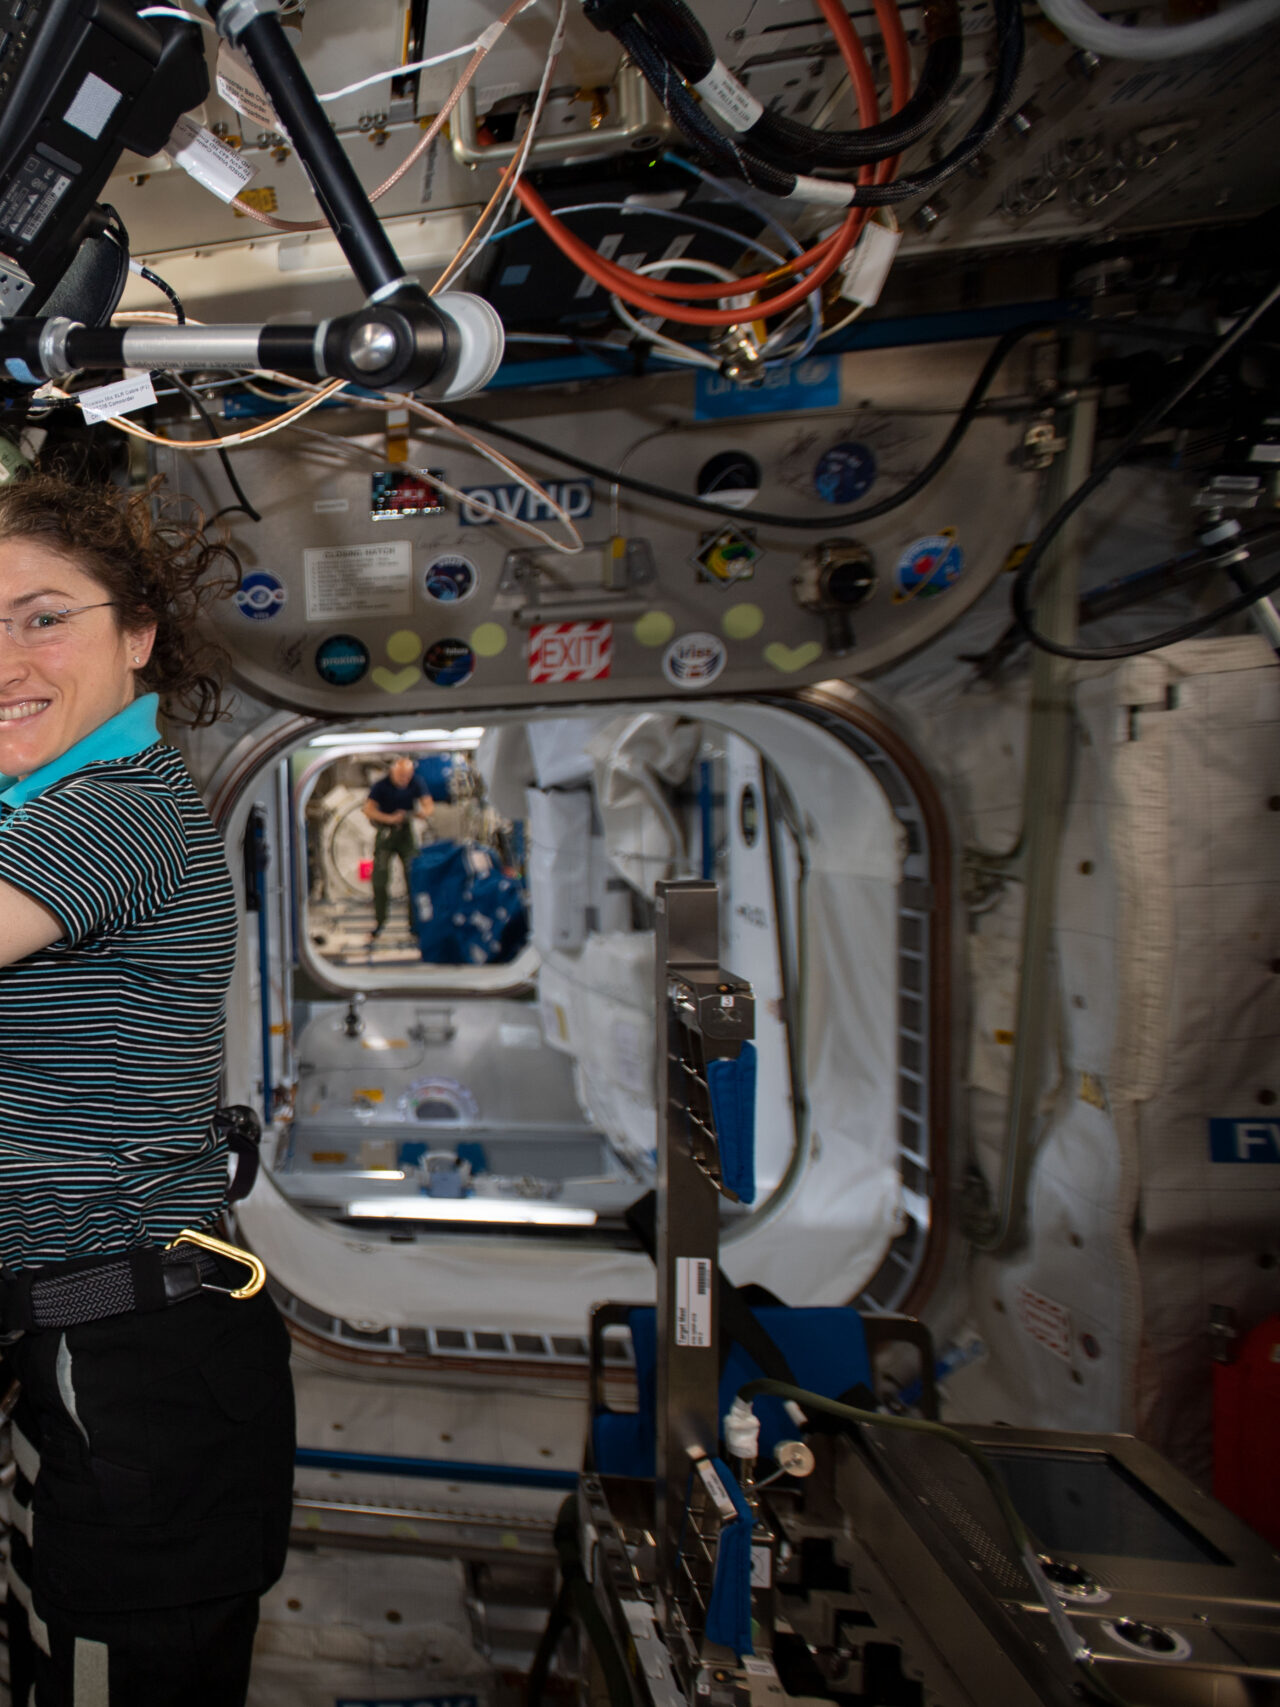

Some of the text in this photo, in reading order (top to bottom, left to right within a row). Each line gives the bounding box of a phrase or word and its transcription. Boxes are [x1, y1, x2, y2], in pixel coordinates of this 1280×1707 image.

[213, 152, 228, 166] Video
[461, 482, 593, 525] OVHD
[365, 547, 396, 556] HATCH
[541, 635, 600, 669] EXIT
[320, 653, 367, 669] proxima
[678, 1324, 688, 1343] Target
